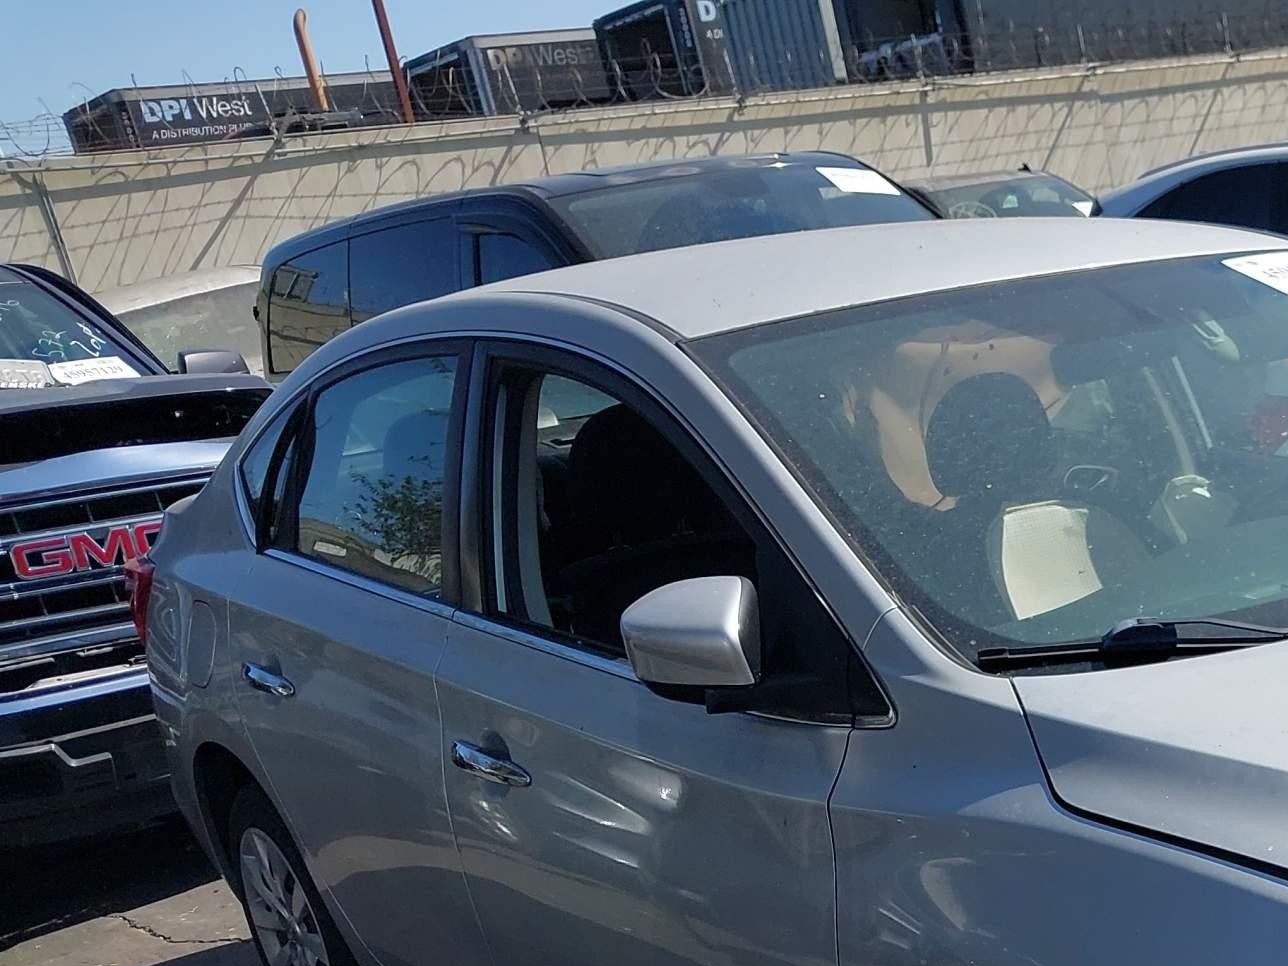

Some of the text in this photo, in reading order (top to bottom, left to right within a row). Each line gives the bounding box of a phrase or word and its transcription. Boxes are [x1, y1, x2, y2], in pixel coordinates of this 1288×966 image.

[142, 95, 253, 123] DPI West
[152, 130, 160, 140] A
[161, 125, 227, 139] DISTRIBUTION
[9, 521, 165, 581] GMC
